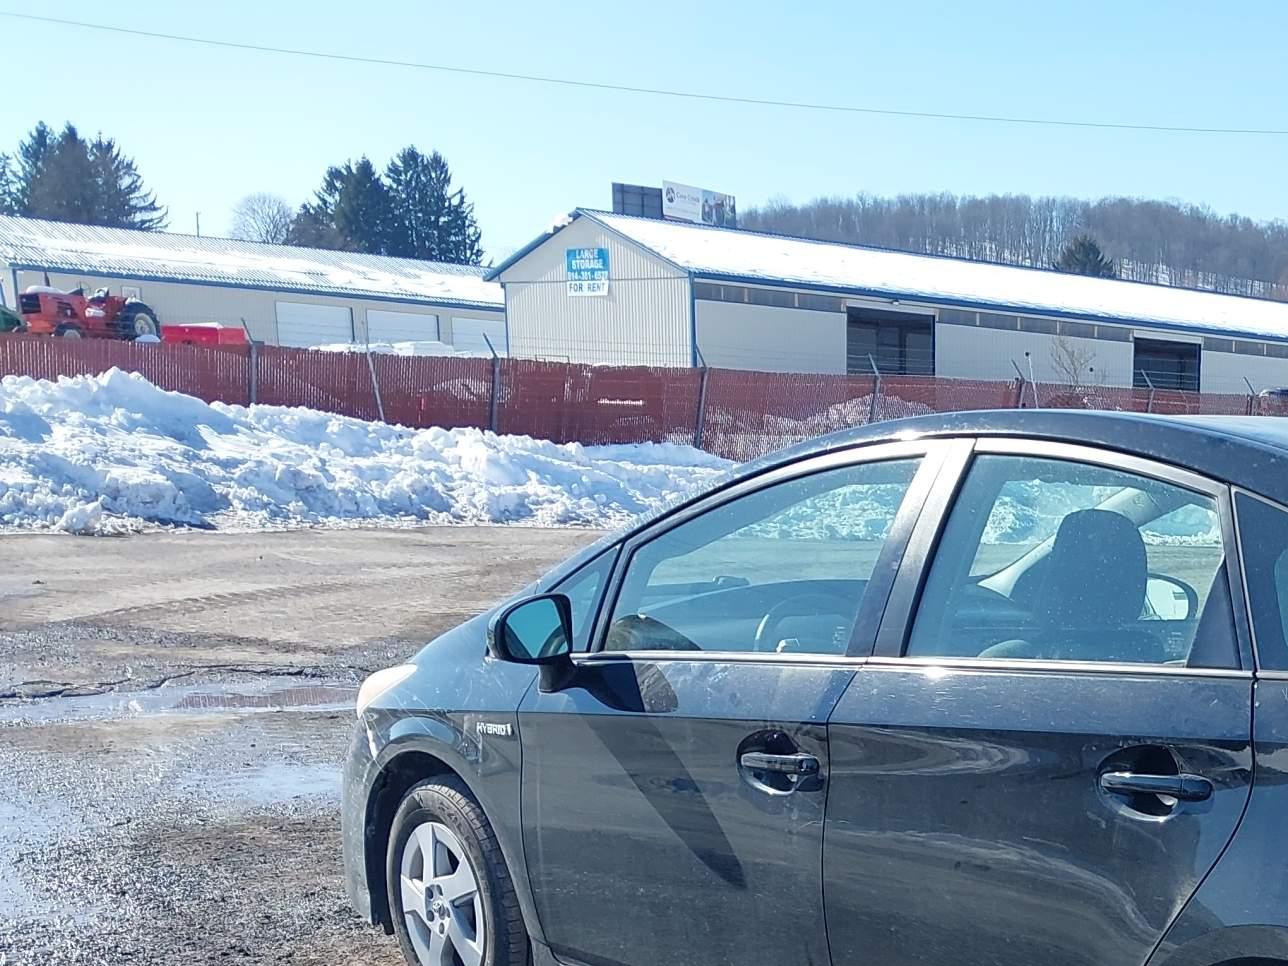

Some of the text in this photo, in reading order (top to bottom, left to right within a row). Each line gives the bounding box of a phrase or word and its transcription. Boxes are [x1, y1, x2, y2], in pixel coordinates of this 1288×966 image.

[576, 248, 598, 259] LARGE
[572, 259, 604, 270] STORAGE
[569, 282, 605, 292] FOR RENT
[476, 722, 506, 735] HYBRID
